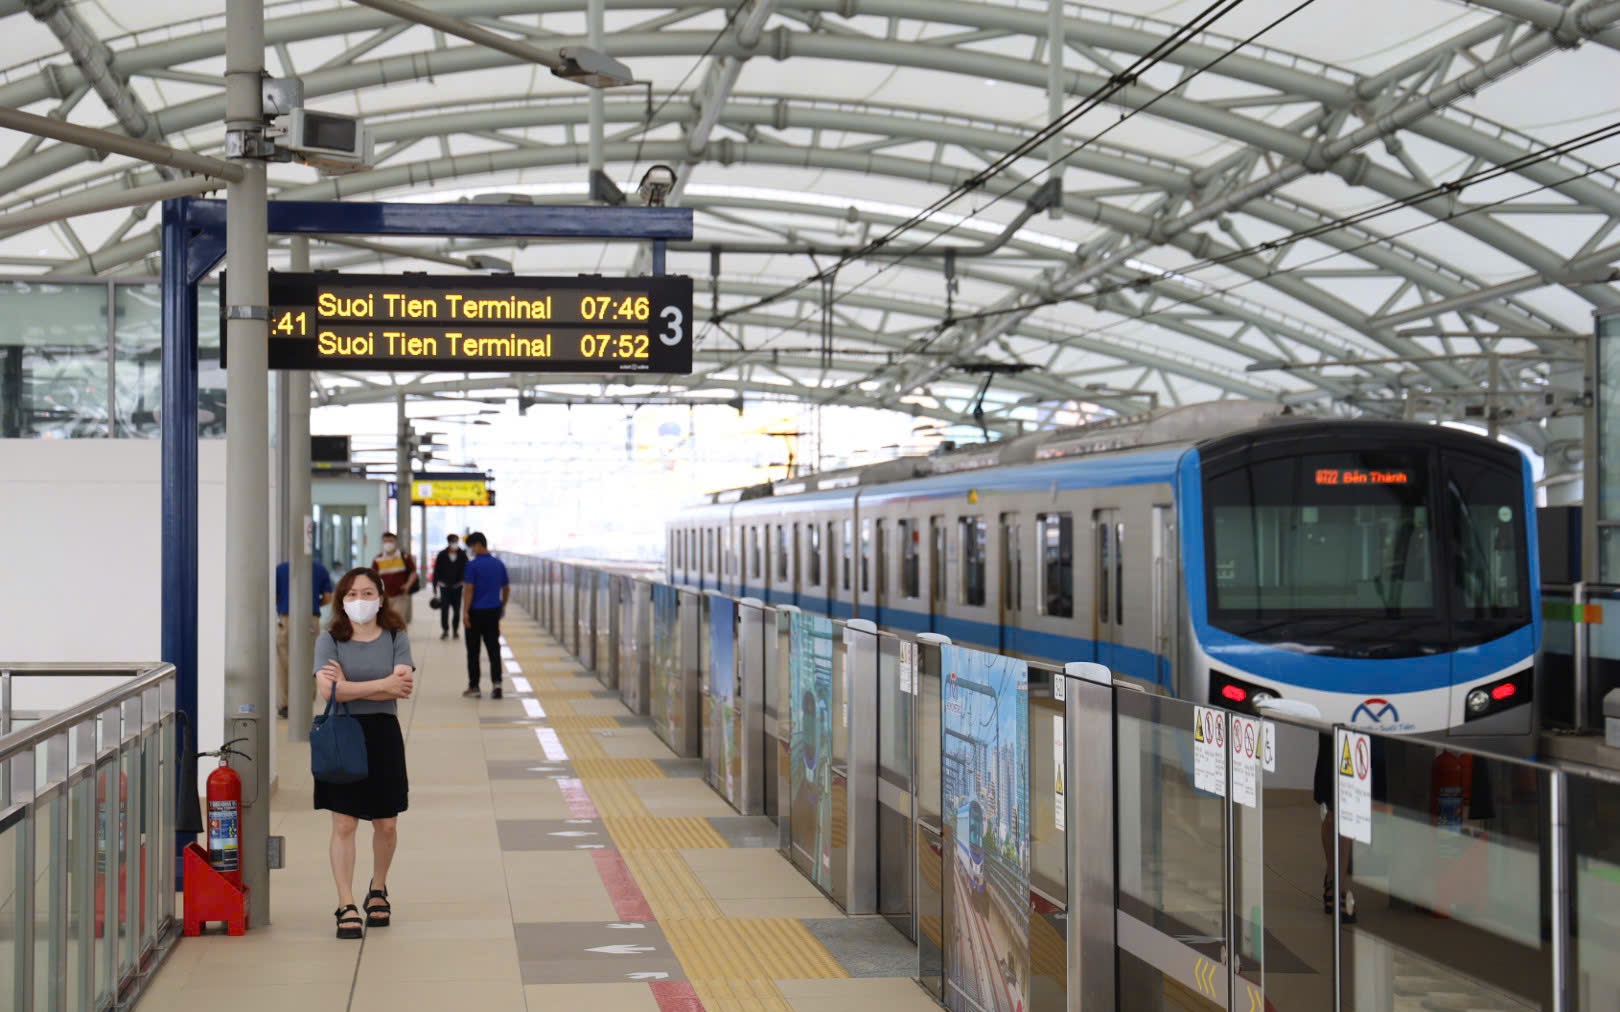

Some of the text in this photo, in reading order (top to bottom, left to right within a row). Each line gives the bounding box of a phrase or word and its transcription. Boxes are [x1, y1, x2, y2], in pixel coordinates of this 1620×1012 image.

[317, 291, 650, 320] Suoi Tien Terminal 07:46
[659, 305, 684, 346] 3
[317, 331, 650, 358] Suoi Tien Terminal 07:52
